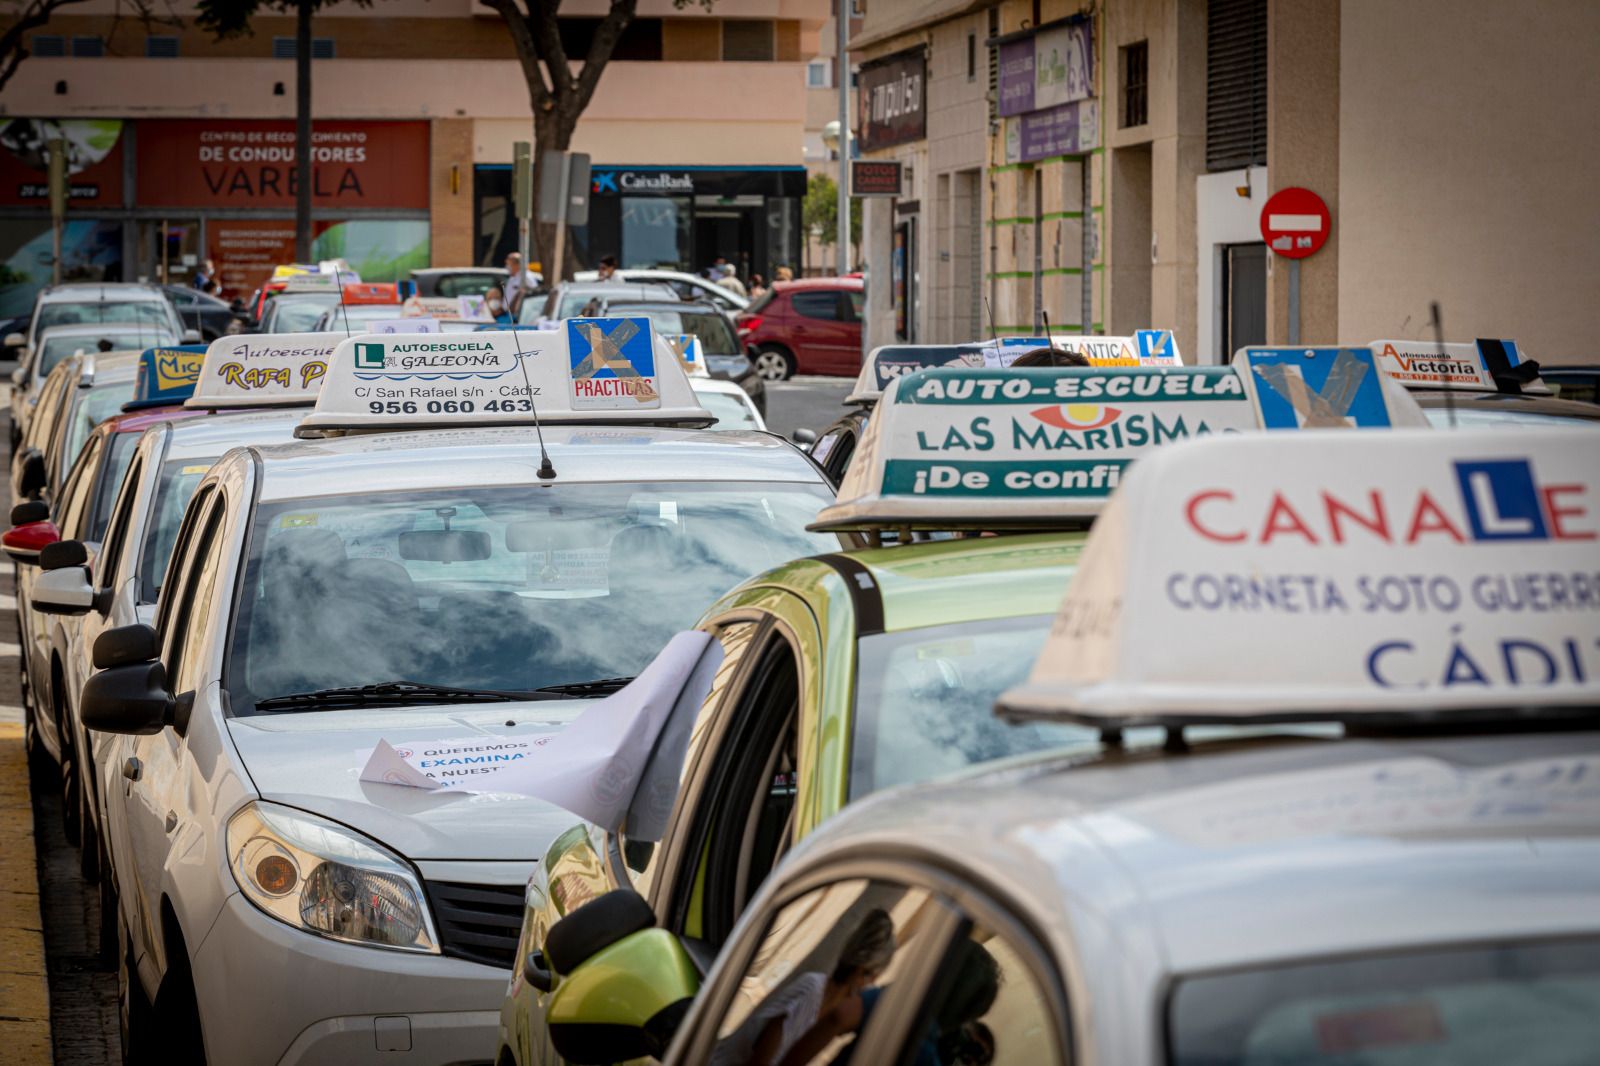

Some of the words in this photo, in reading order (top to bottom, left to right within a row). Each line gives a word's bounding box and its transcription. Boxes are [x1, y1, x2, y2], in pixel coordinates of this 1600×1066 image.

[200, 132, 245, 142] CENTRO
[248, 132, 263, 142] DE
[265, 132, 367, 142] RECOCIMIENTO
[199, 147, 225, 162] DE
[228, 147, 367, 162] CONDUTORES
[202, 167, 364, 197] VARELA
[621, 172, 694, 188] CaixaBank
[392, 342, 494, 353] AUTOESCUELA
[401, 353, 501, 370] GALEONA
[1398, 358, 1475, 375] Victoria
[218, 361, 291, 389] RAFA
[354, 387, 371, 397] C/
[376, 387, 405, 398] San
[410, 387, 457, 397] Rafael
[462, 387, 484, 397] s/n
[499, 385, 541, 397] Cádiz
[575, 379, 653, 397] PRACTICAS
[917, 373, 1242, 399] AUTO-ESCUELA
[369, 401, 418, 414] 956
[427, 400, 475, 413] 060
[484, 400, 532, 412] 463
[916, 416, 995, 451] LAS
[913, 466, 990, 493] ¡De
[1167, 574, 1350, 612] CORNETA
[1356, 574, 1462, 613] SOTO
[1365, 623, 1600, 688] CÁDI
[424, 743, 528, 756] QUEREMOS
[420, 752, 532, 768] EXAMINA
[442, 766, 505, 777] NUEST
